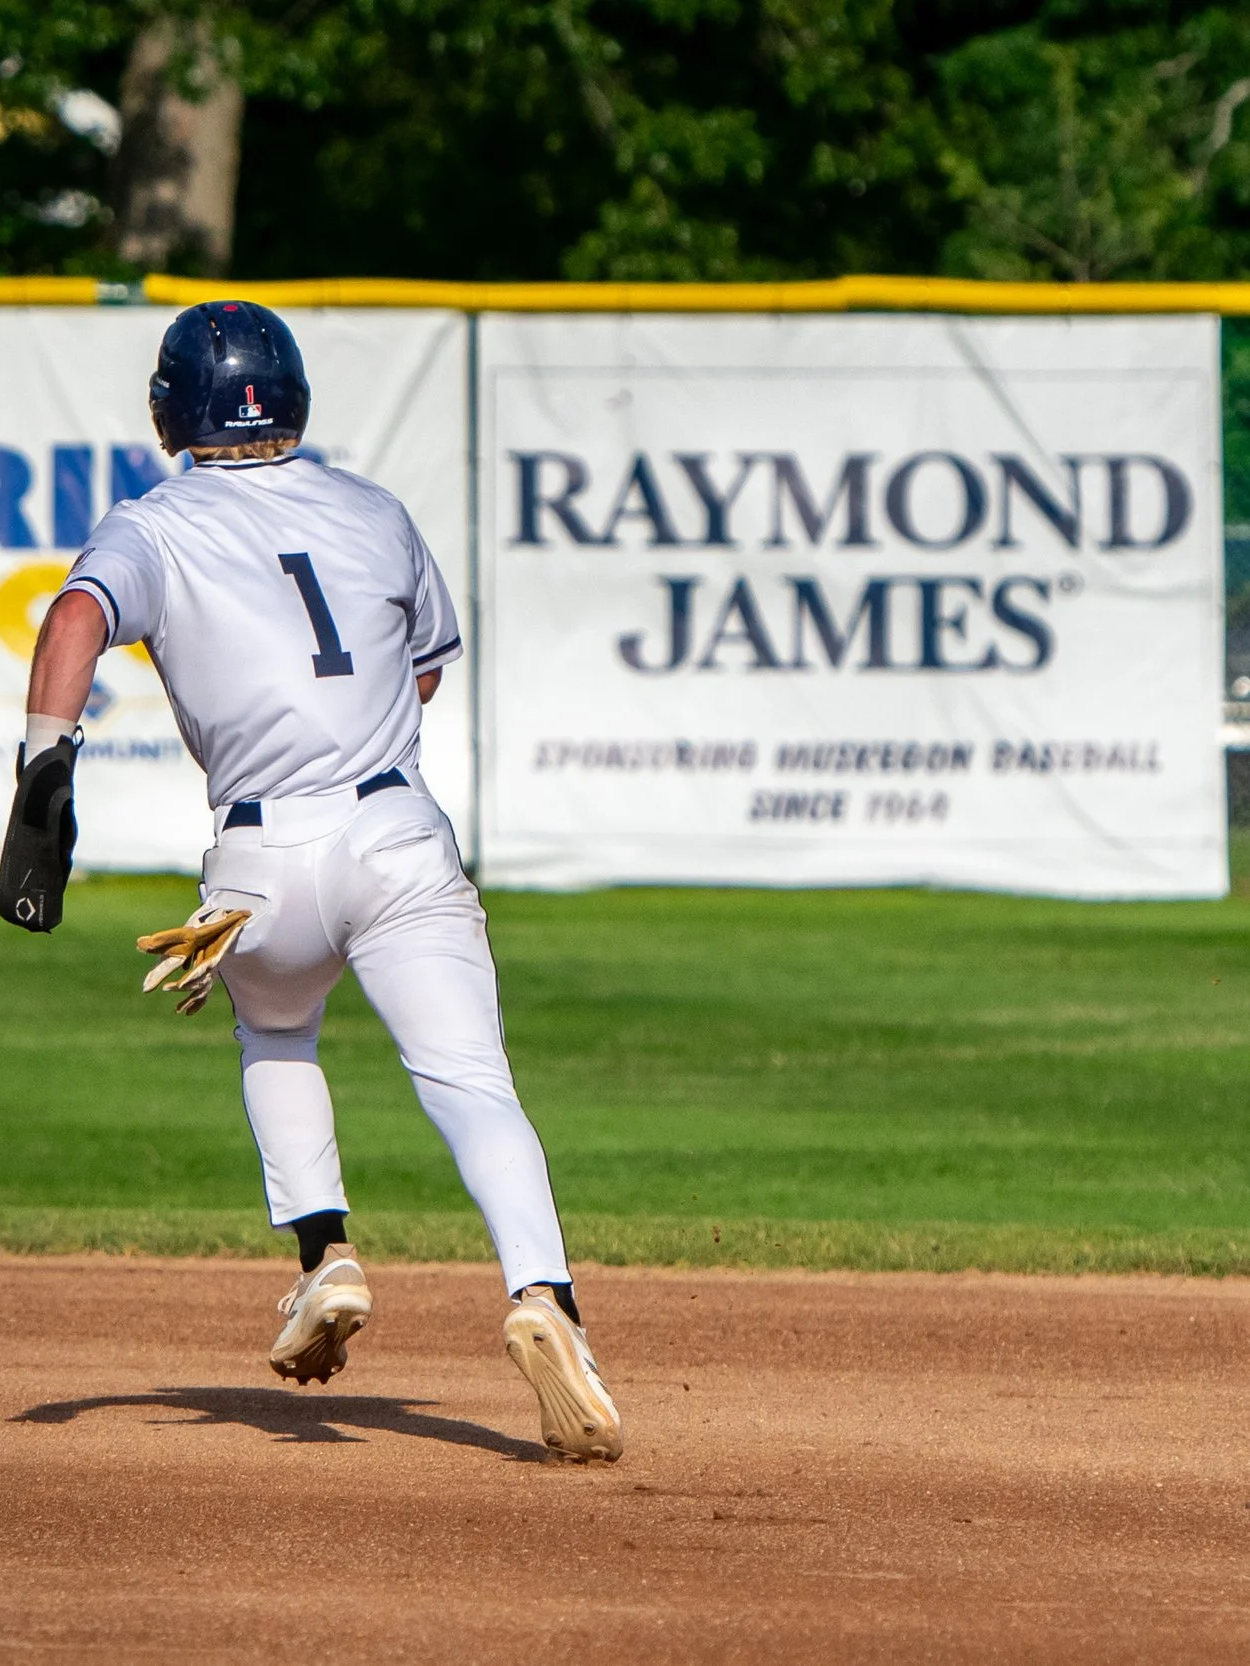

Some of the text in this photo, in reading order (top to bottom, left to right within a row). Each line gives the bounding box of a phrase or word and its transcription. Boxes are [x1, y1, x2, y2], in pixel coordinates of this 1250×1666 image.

[245, 384, 254, 404] 1
[224, 417, 274, 427] RAWLINGS
[507, 449, 1195, 553] RAYMOND
[277, 552, 354, 678] 1
[617, 574, 1056, 674] JAMES
[773, 738, 976, 775] MUSKEGON
[988, 738, 1161, 775] BASEBALL
[747, 789, 850, 822] SINCE
